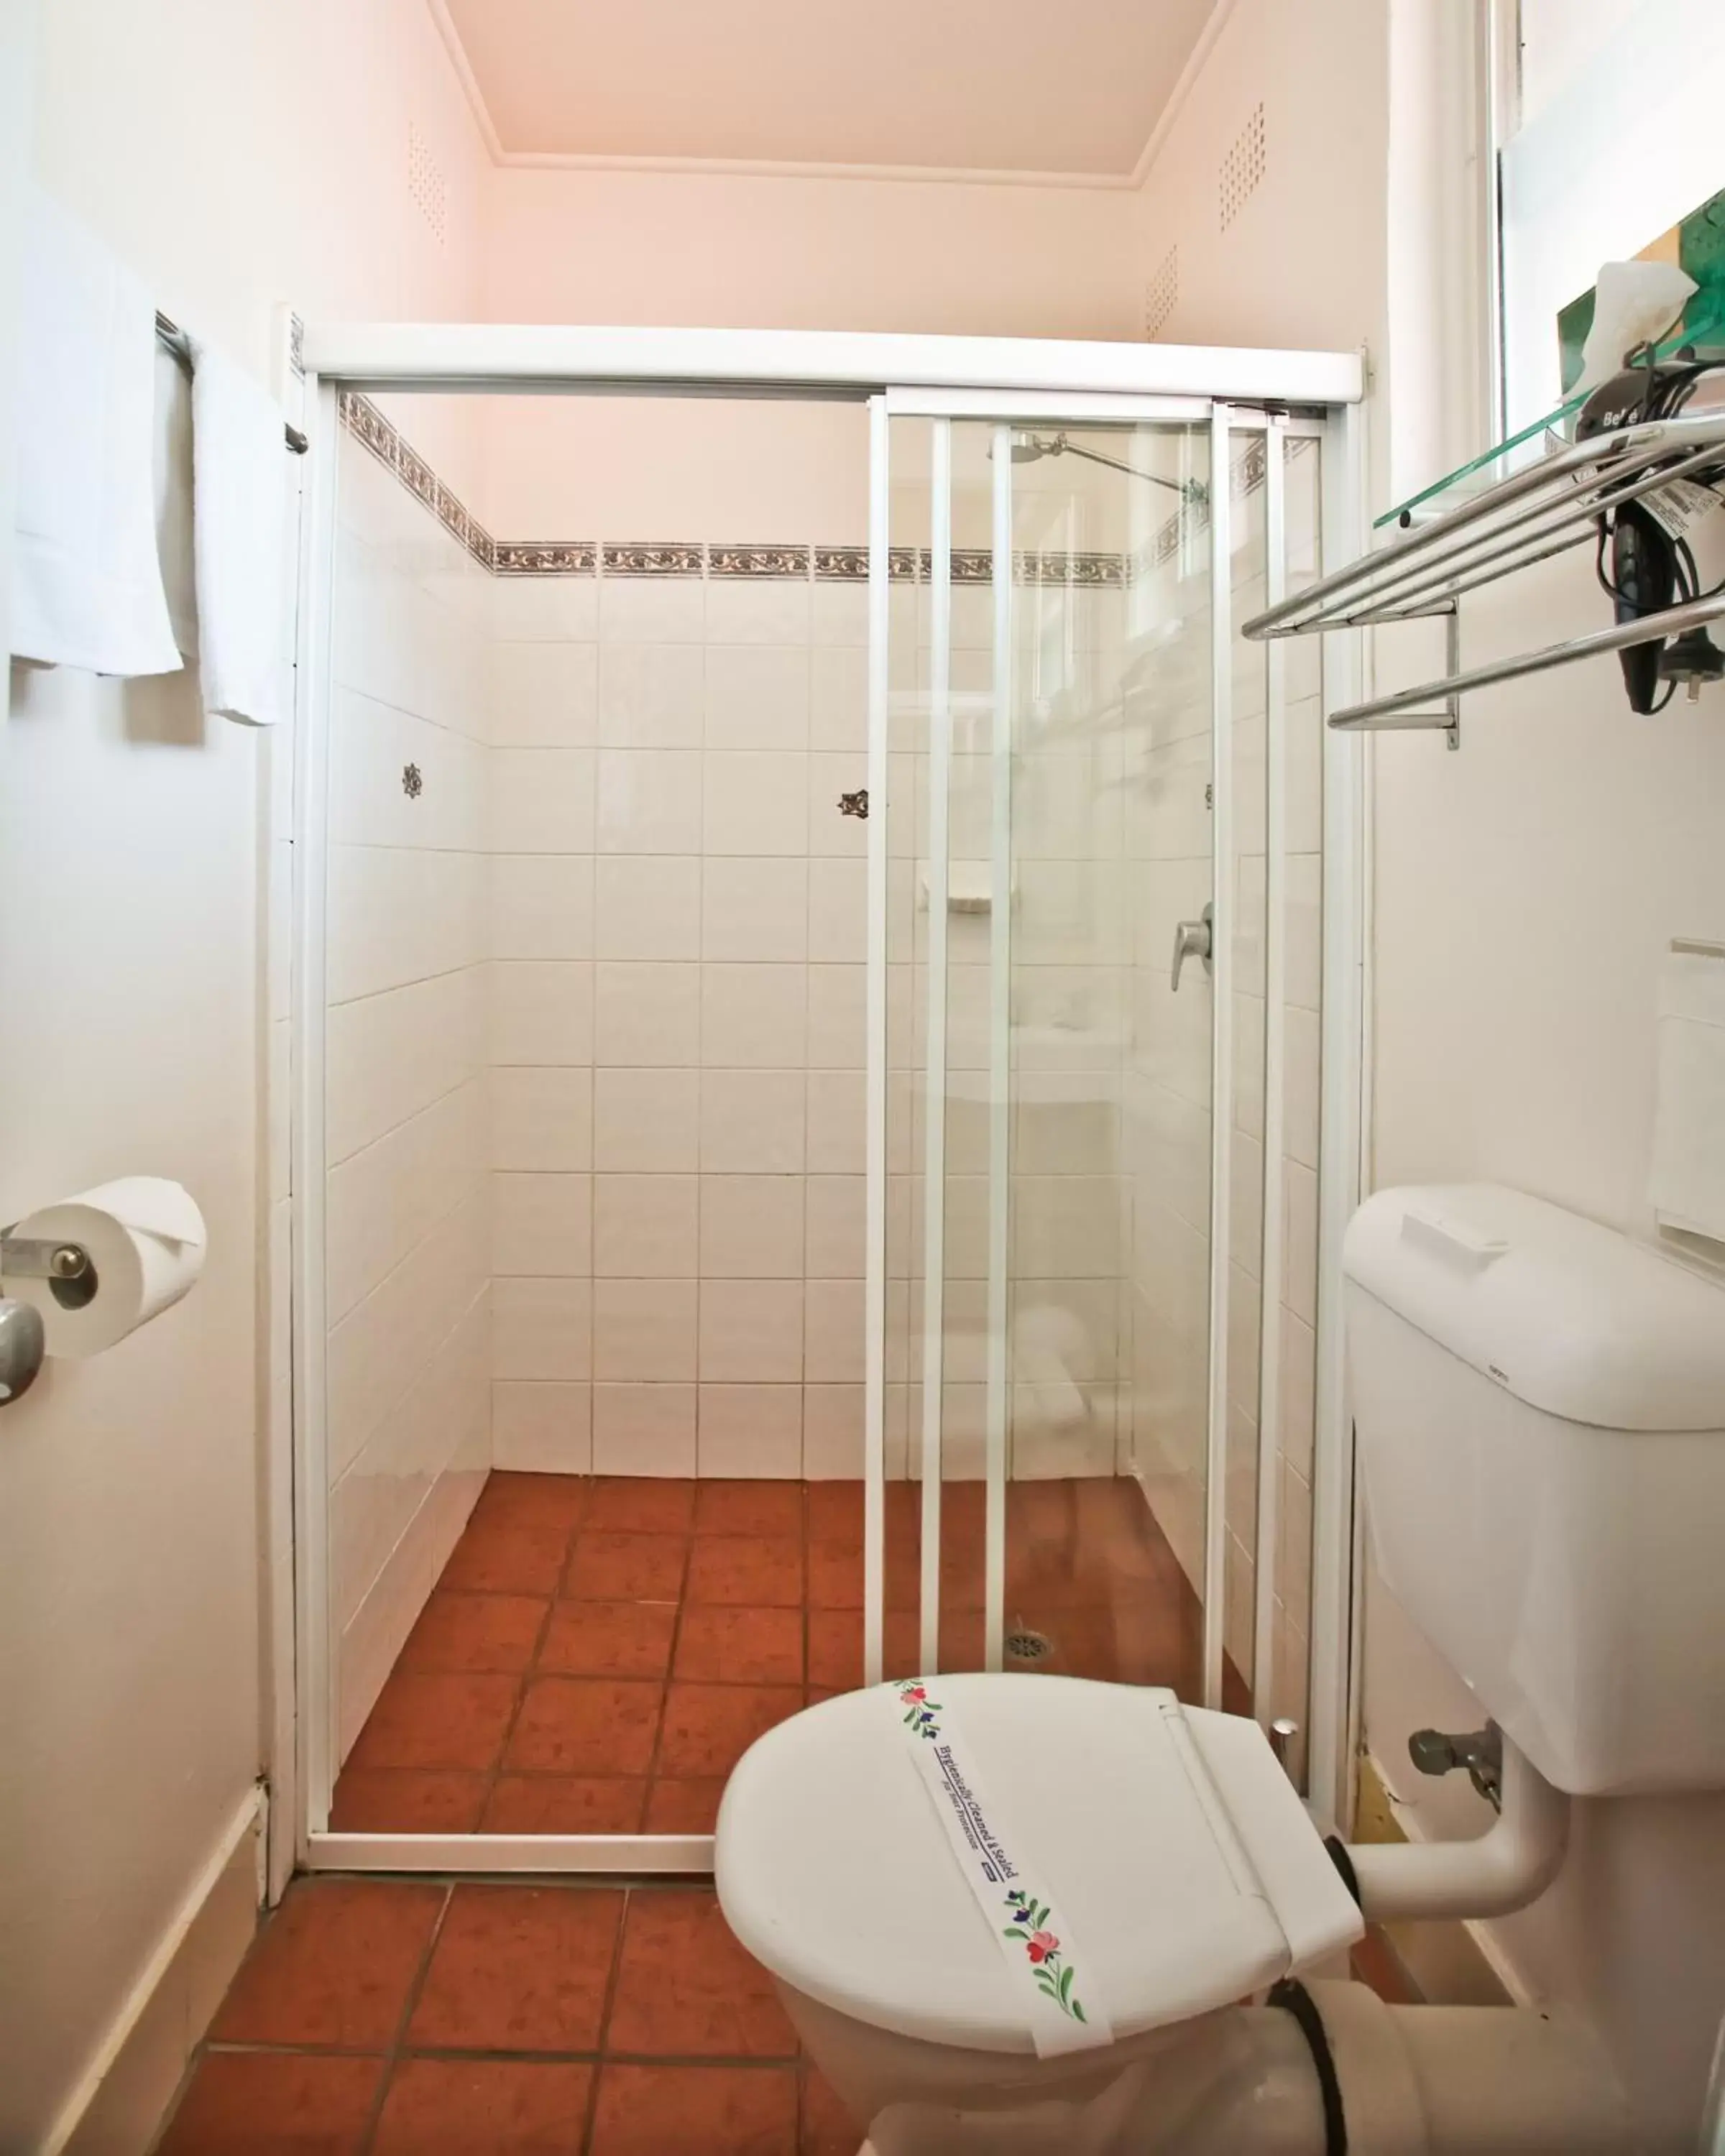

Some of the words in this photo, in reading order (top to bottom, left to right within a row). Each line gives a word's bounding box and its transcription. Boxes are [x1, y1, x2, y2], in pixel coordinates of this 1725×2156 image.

[939, 1745, 973, 1800] Hygienically
[967, 1802, 995, 1841] Cleaned
[992, 1848, 1019, 1879] Sealed
[955, 1810, 978, 1850] Protection
